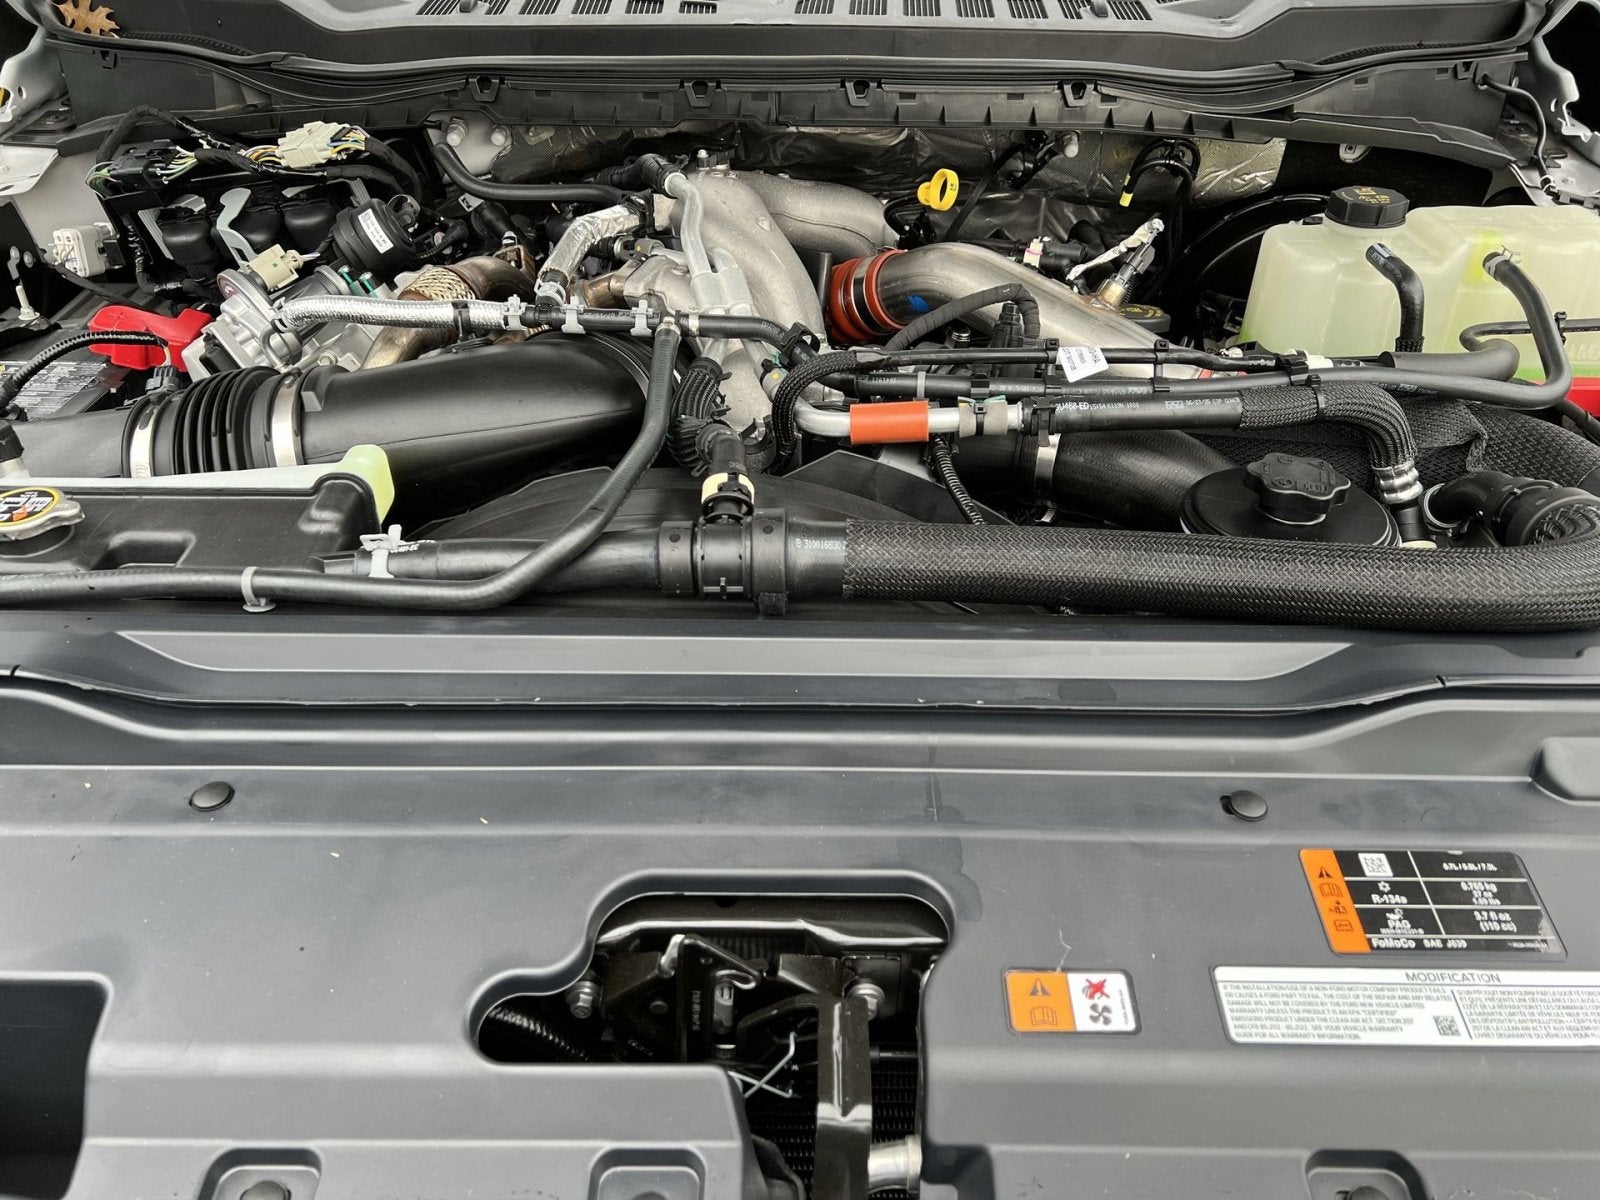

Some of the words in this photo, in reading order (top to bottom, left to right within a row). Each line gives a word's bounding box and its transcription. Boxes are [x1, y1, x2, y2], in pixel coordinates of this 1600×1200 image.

[1371, 894, 1408, 904] R-134a
[1388, 920, 1411, 929] PAG
[1371, 938, 1416, 948] FoMoCo
[1423, 938, 1443, 948] SAE
[1405, 972, 1501, 982] MODIFICATION
